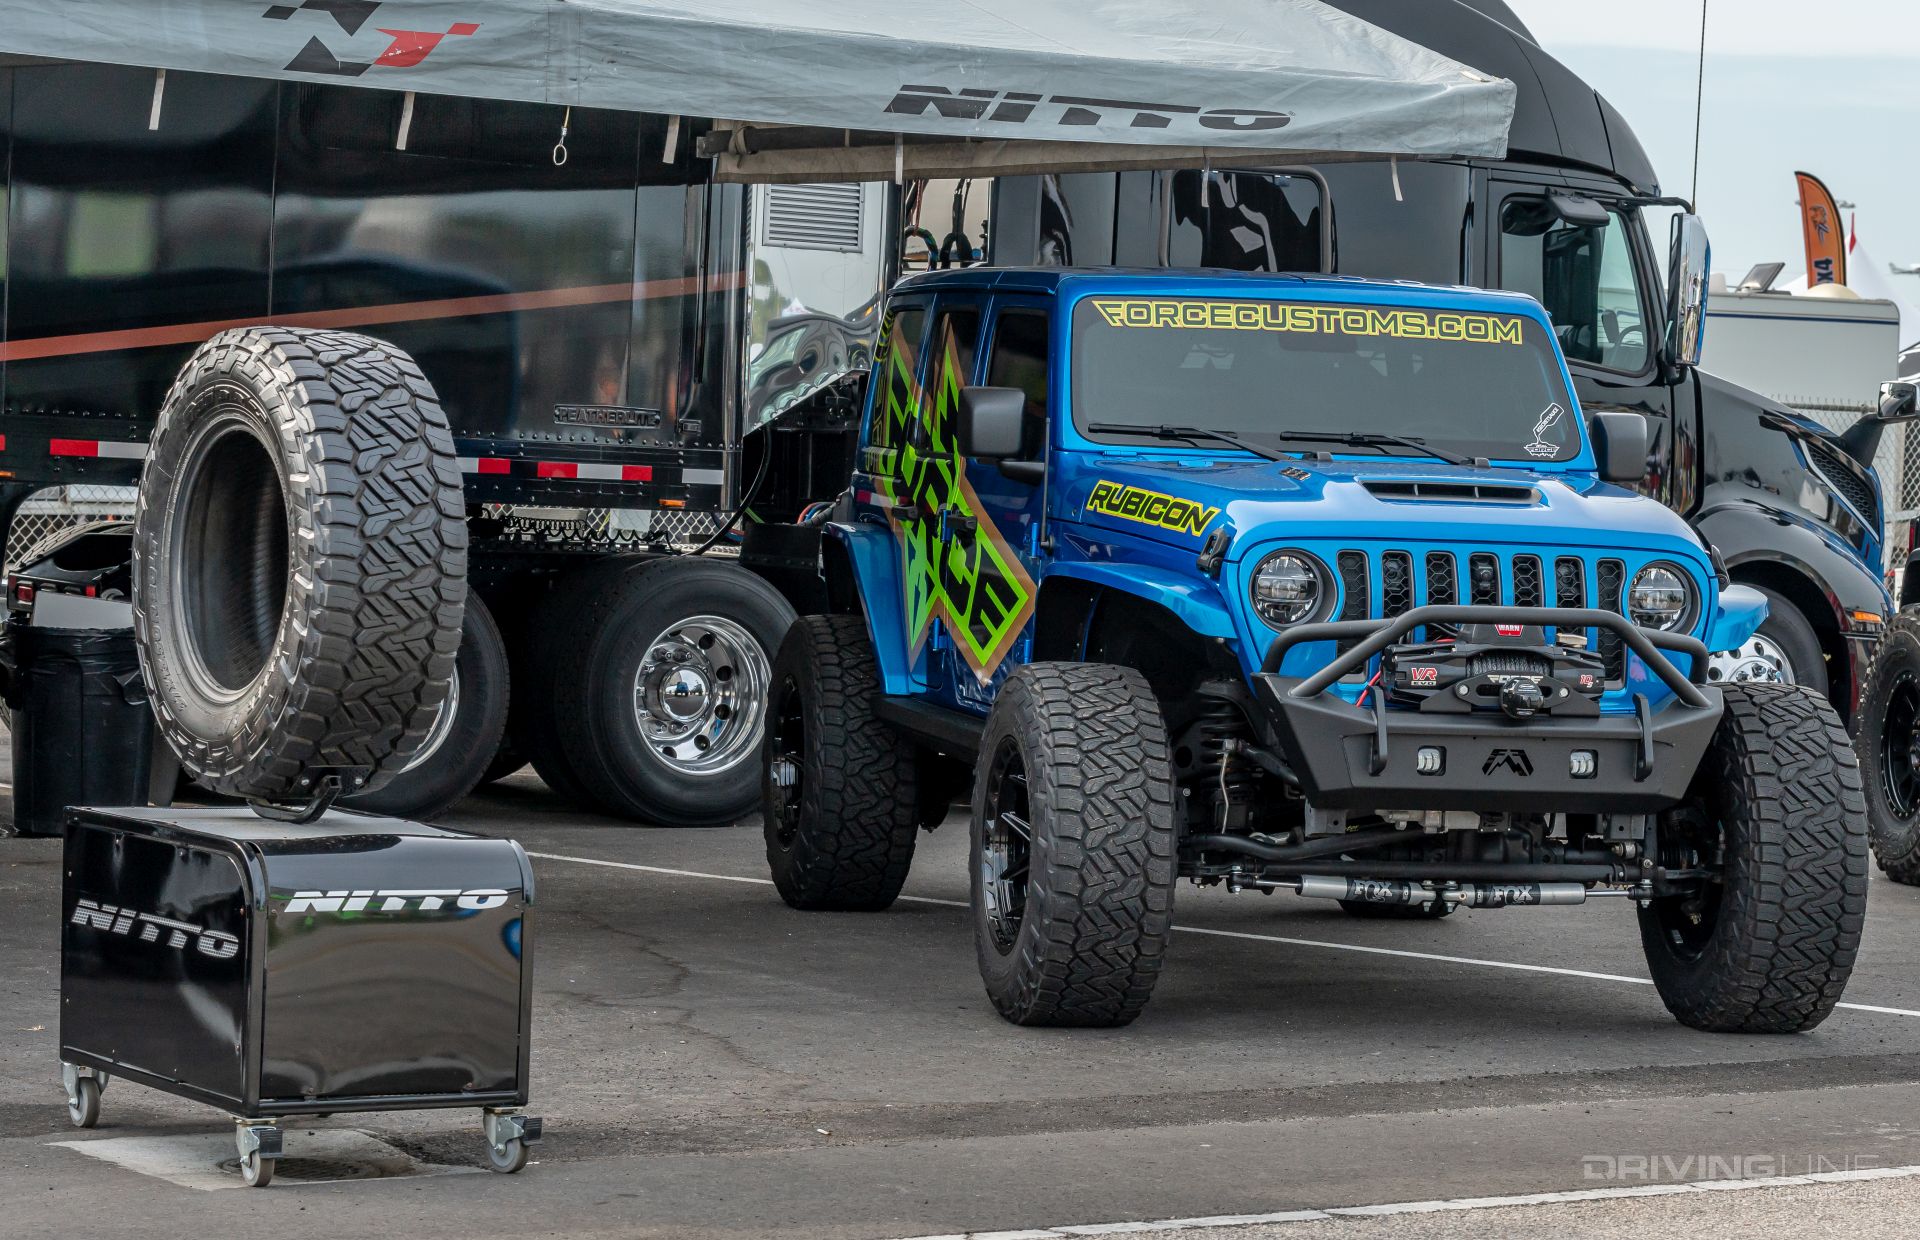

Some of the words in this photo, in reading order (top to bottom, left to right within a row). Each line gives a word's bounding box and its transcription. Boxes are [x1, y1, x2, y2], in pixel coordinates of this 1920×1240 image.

[883, 84, 1291, 131] NITTO
[1092, 301, 1523, 345] FORCECUSTOMS.COM
[1087, 481, 1221, 536] RUBICON
[1411, 667, 1437, 681] VR
[284, 889, 508, 912] NITTO
[1354, 879, 1393, 901] FOX
[1493, 885, 1534, 904] FOX
[71, 898, 239, 958] NITTO
